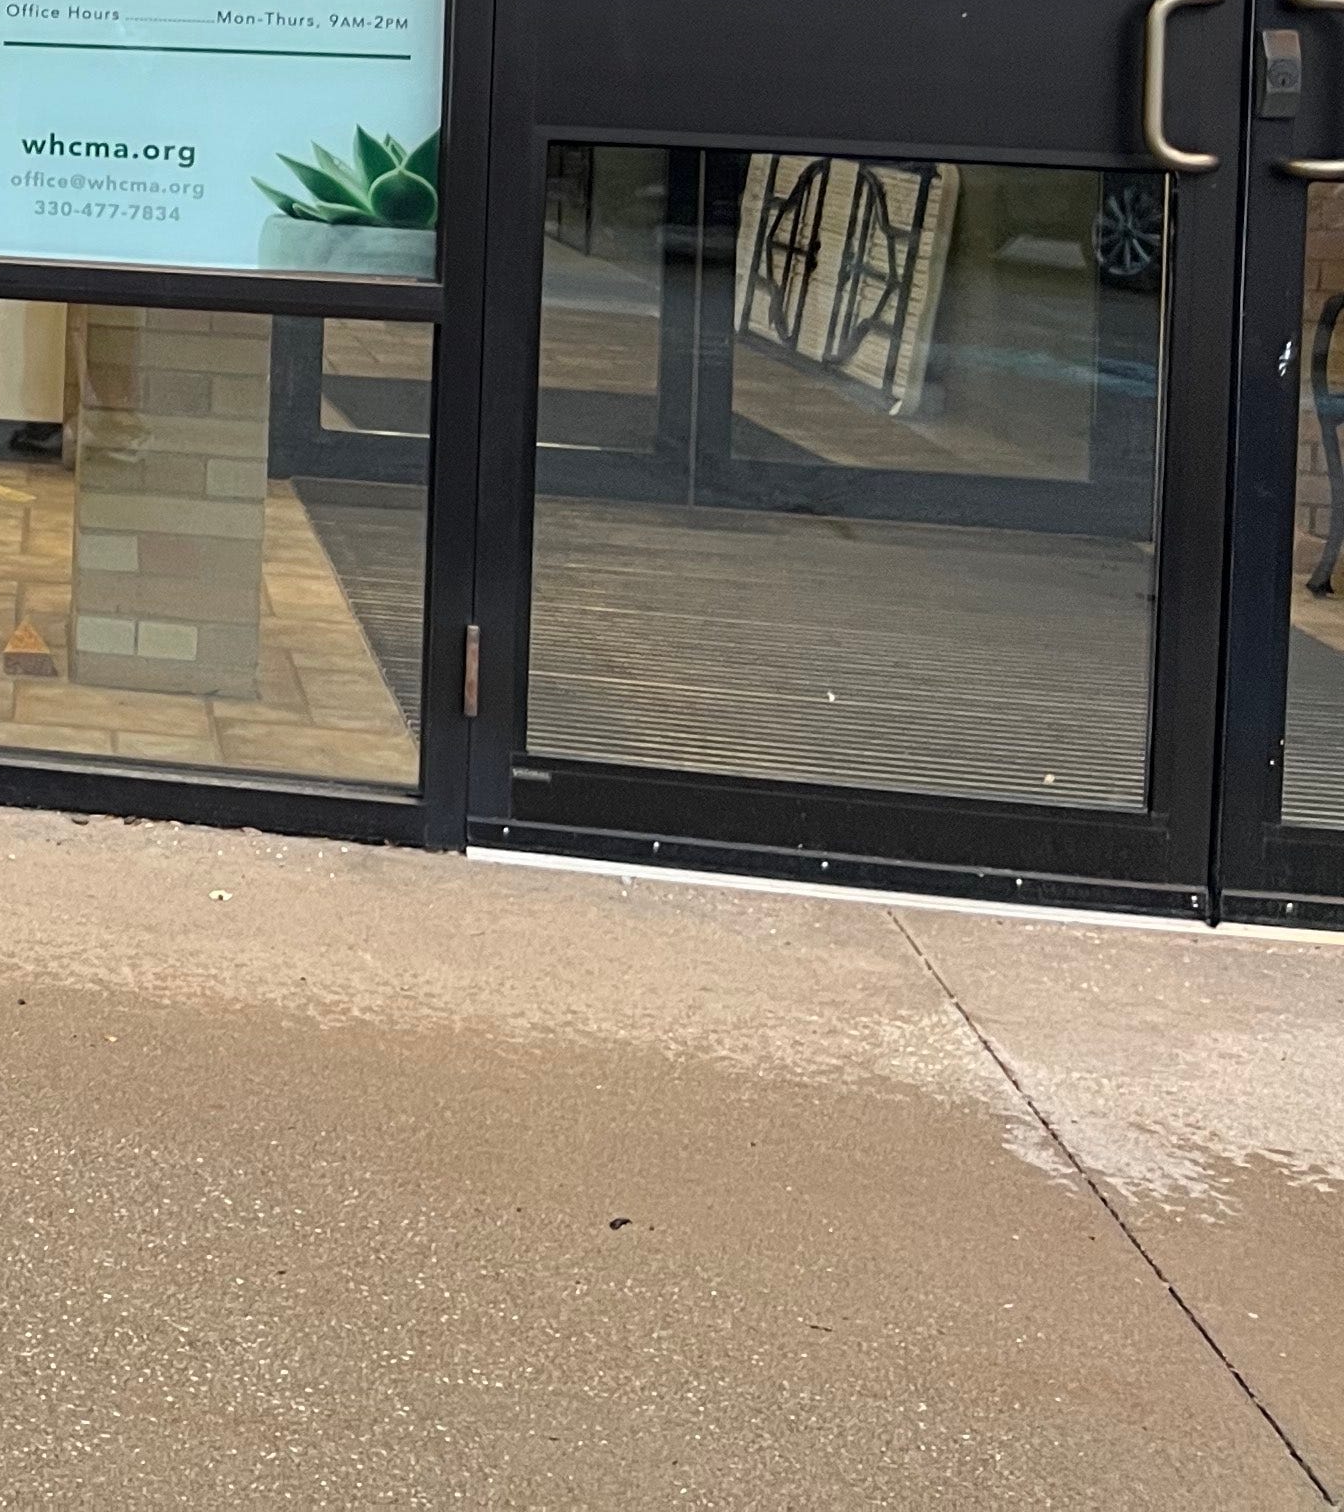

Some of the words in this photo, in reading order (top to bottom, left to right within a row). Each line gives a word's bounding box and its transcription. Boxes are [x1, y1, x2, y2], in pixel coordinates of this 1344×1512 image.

[6, 3, 61, 19] Office
[67, 5, 121, 22] Hours
[216, 10, 321, 30] Mon-Thurs,
[328, 13, 410, 31] 9AM-2PM
[21, 132, 197, 168] whcma.org
[10, 171, 206, 199] office@whcma.org
[33, 200, 181, 222] 330-477-7834
